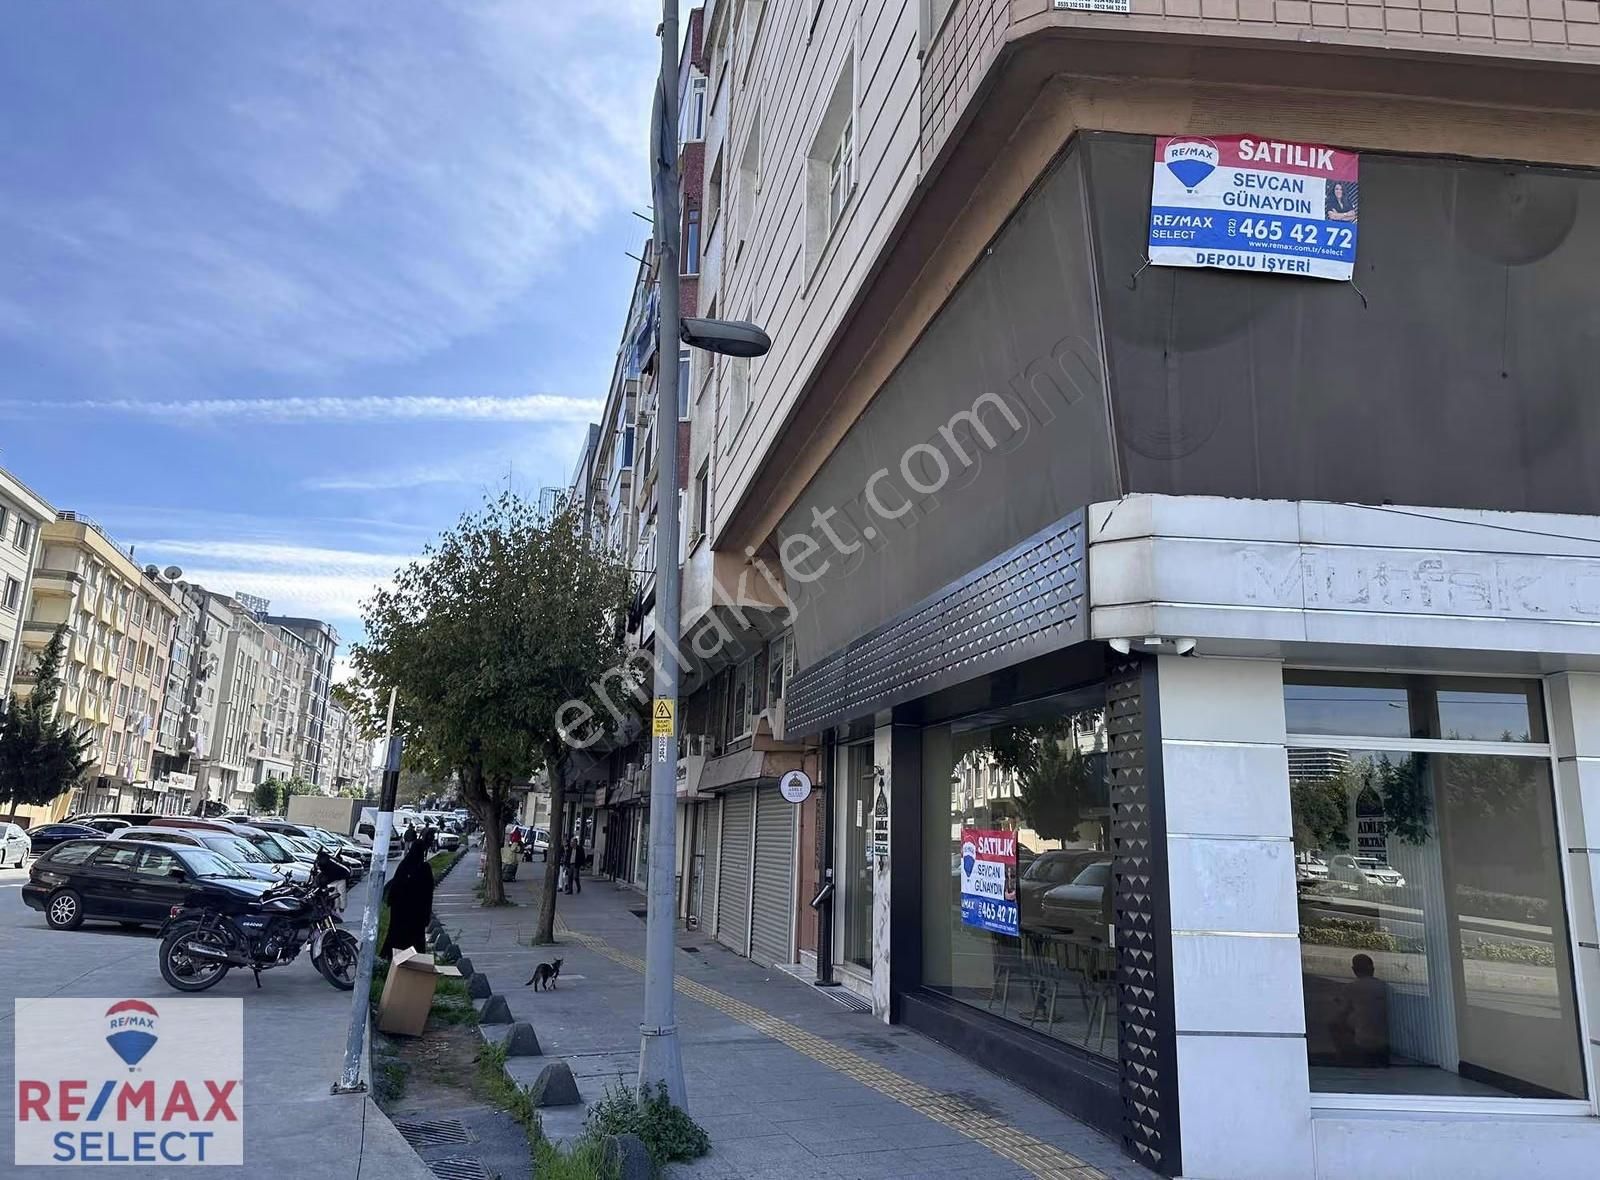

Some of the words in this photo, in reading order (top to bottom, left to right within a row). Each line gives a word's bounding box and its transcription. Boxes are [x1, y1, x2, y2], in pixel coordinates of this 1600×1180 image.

[1171, 147, 1213, 160] RE/MAX
[1238, 138, 1335, 171] SATILIK
[1233, 172, 1304, 194] SEVCAN
[1222, 191, 1311, 214] GÜNAYDIN
[1152, 214, 1214, 228] RE/MAX
[1152, 229, 1196, 240] SELECT
[1239, 218, 1282, 241] 465
[1290, 223, 1318, 244] 42
[1326, 227, 1353, 249] 72
[1249, 240, 1344, 257] www.remax.com.tr/select
[1196, 252, 1256, 268] DEPOLU
[1262, 254, 1311, 273] İŞYERİ
[978, 836, 1014, 857] SATILIK
[977, 863, 1001, 879] SEVCAN
[981, 902, 996, 921] 465
[997, 904, 1006, 923] 42
[1007, 906, 1017, 925] 72
